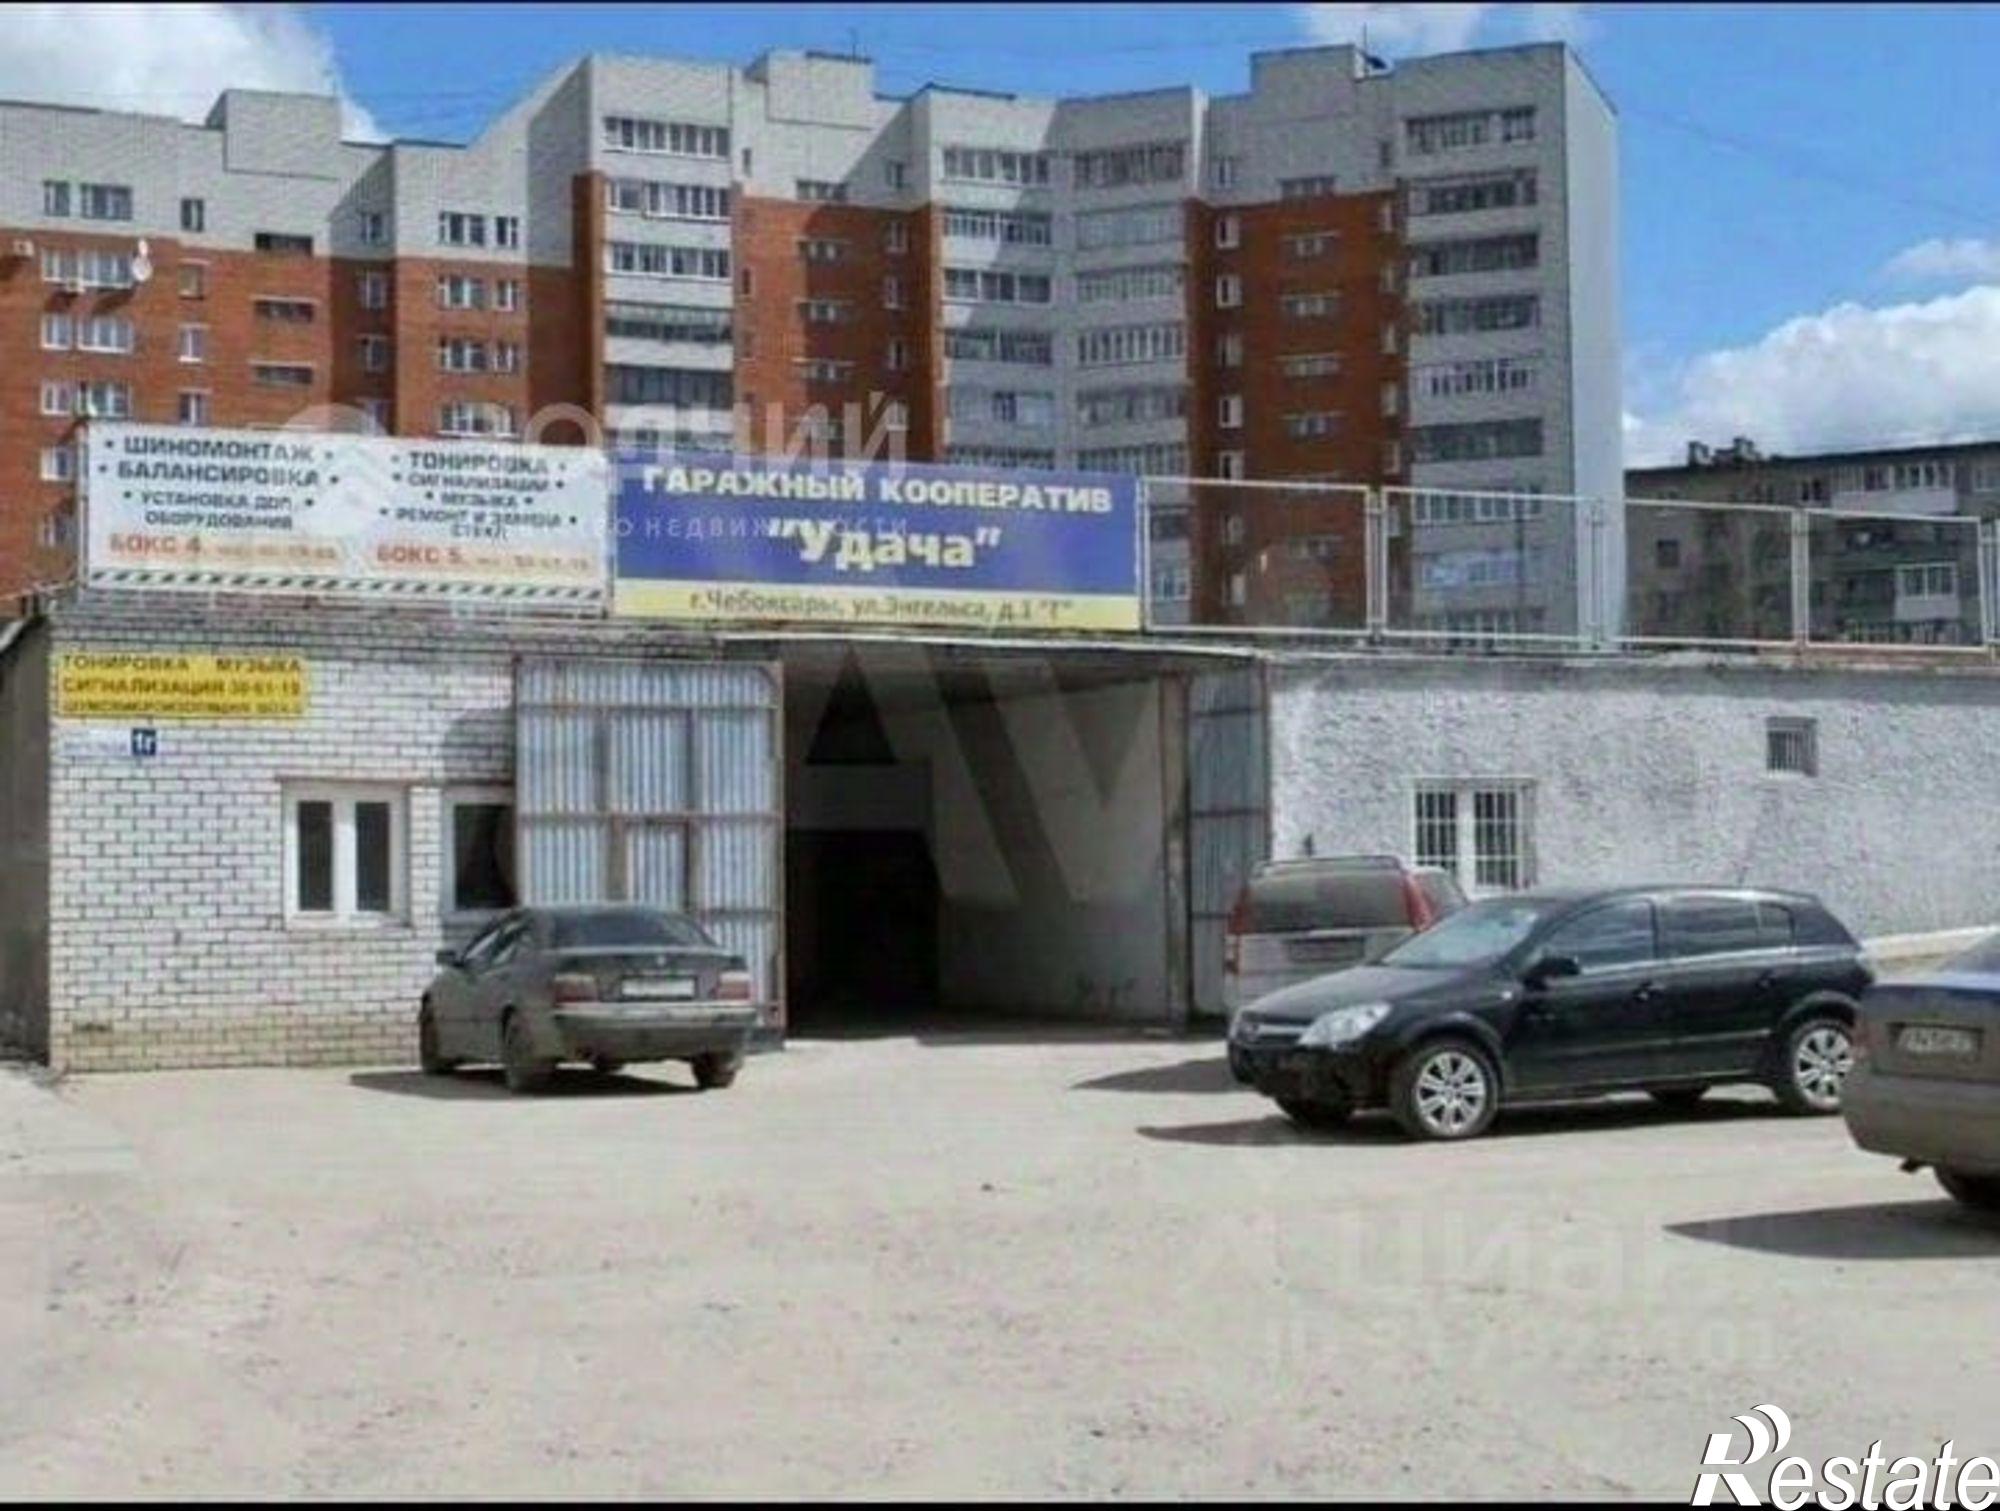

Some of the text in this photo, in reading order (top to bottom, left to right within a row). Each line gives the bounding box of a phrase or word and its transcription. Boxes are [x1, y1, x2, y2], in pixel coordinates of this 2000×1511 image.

[123, 436, 315, 460] ШИНОМОНТАЖ
[408, 452, 549, 473] ТОНИРОВКА
[117, 461, 320, 486] БАЛАНСИРОВКА
[642, 465, 866, 500] ГАРАЖНЫЙ
[141, 490, 249, 508] УСТАНОВКА
[879, 478, 1113, 512] КООПЕРАТИВ
[396, 507, 468, 523] РЕМОНТ
[376, 545, 439, 565] БОКС
[63, 655, 300, 673] ТОНИРОВКА МУЗЫКА
